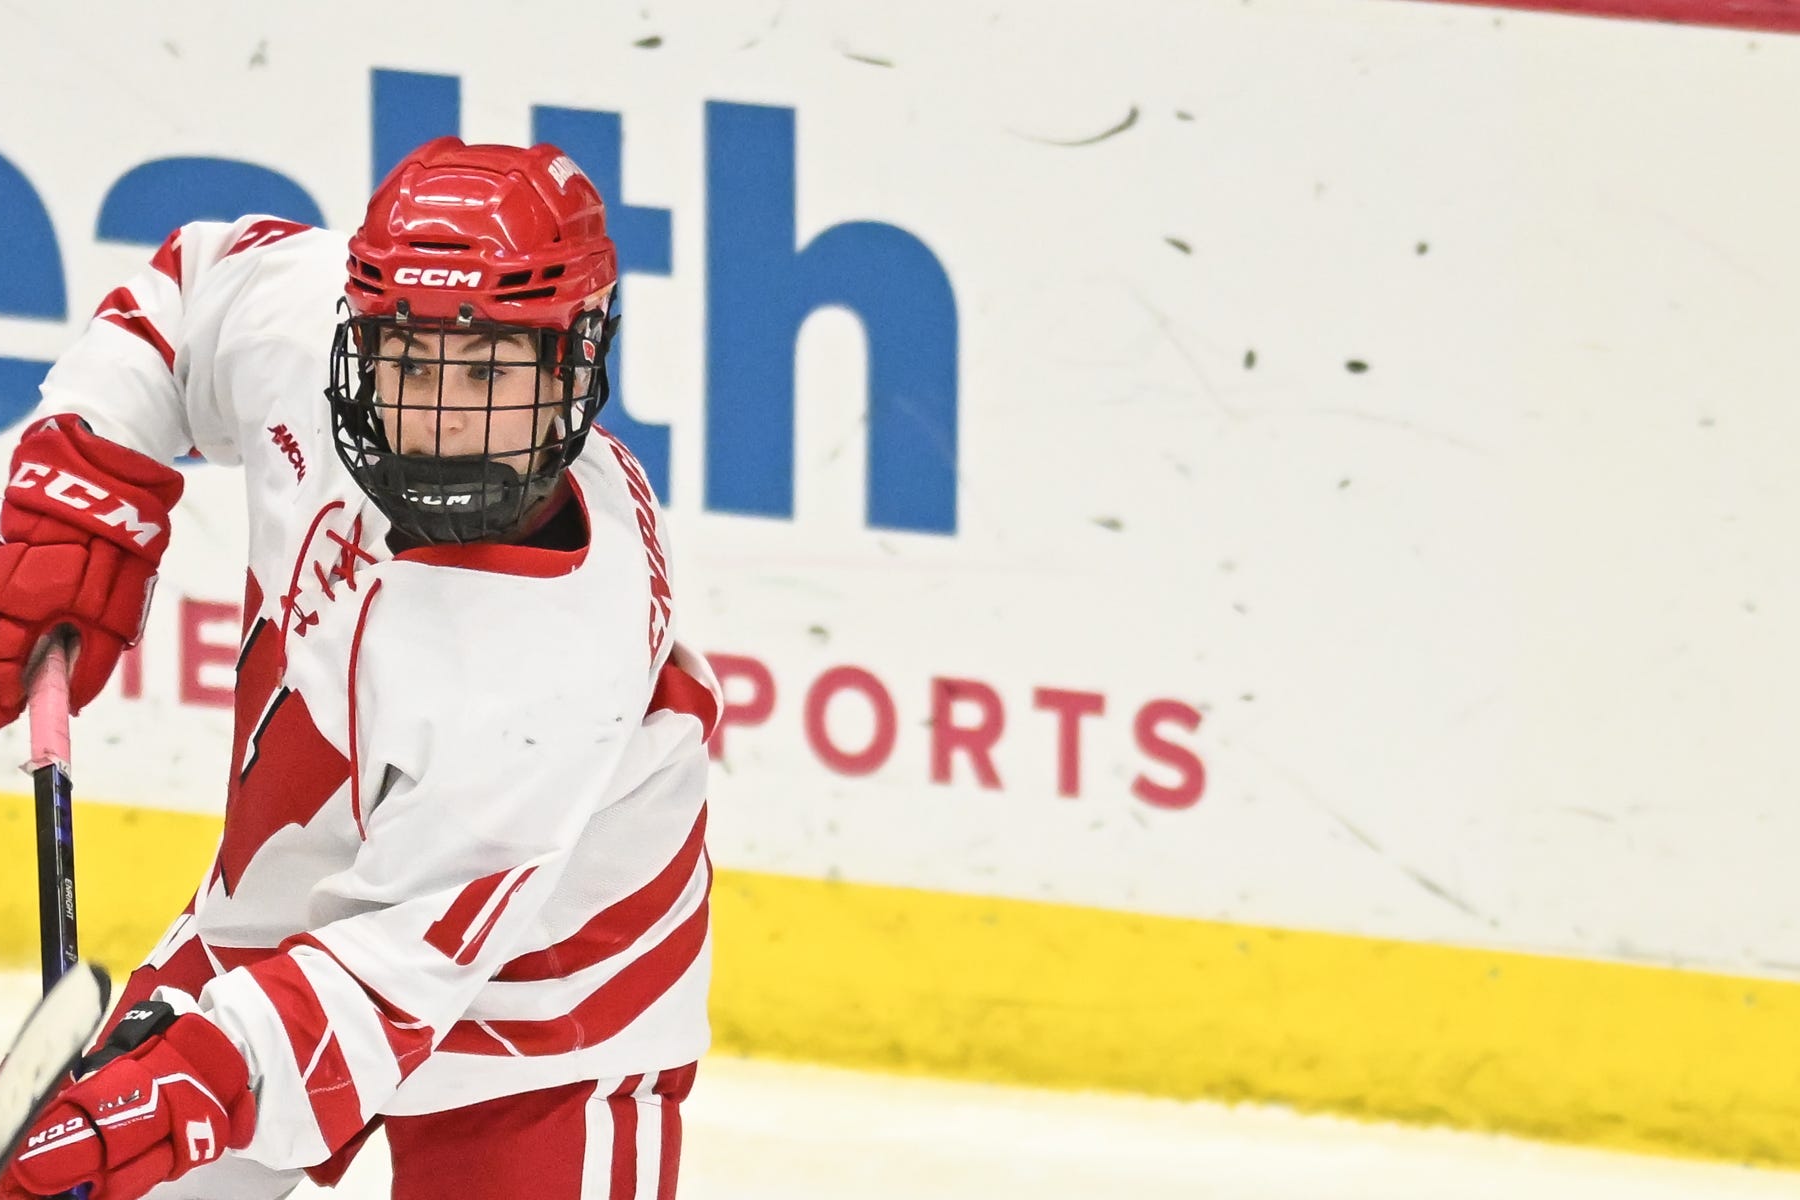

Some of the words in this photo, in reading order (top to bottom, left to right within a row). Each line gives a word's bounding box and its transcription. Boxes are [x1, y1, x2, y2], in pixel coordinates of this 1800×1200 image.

[393, 267, 482, 288] CCM
[9, 461, 162, 548] CCM
[704, 651, 1207, 813] PORTS
[63, 877, 74, 921] ENRIGHT
[28, 1117, 84, 1148] CCM
